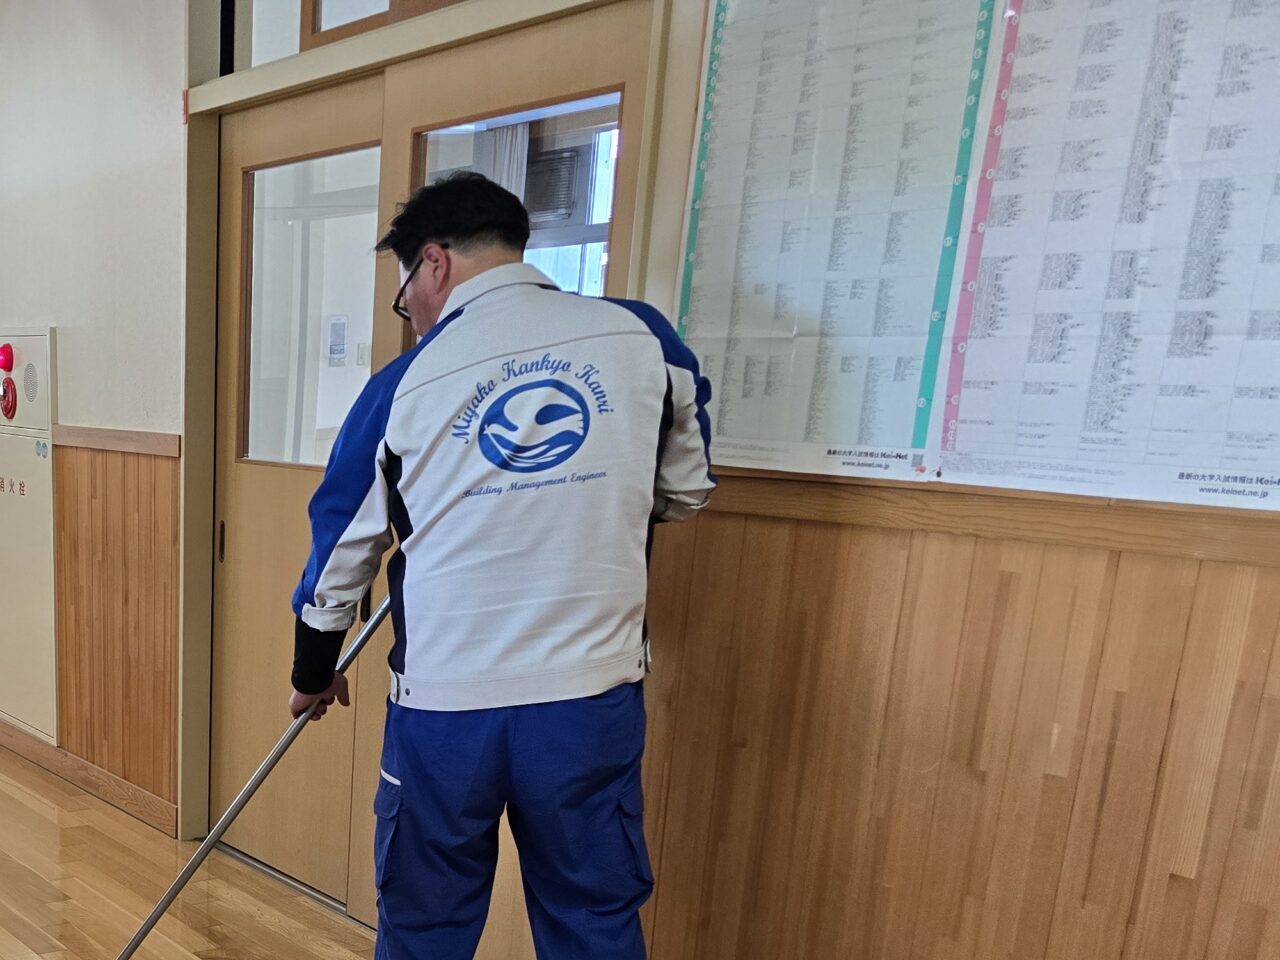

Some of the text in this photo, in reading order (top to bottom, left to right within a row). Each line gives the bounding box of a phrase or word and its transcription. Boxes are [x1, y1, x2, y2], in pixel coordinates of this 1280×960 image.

[451, 352, 614, 445] Miyako Kankyo Kanri
[506, 475, 568, 494] Management
[570, 471, 608, 484] Engineer
[1198, 486, 1269, 499] www.keinet.ne.jp
